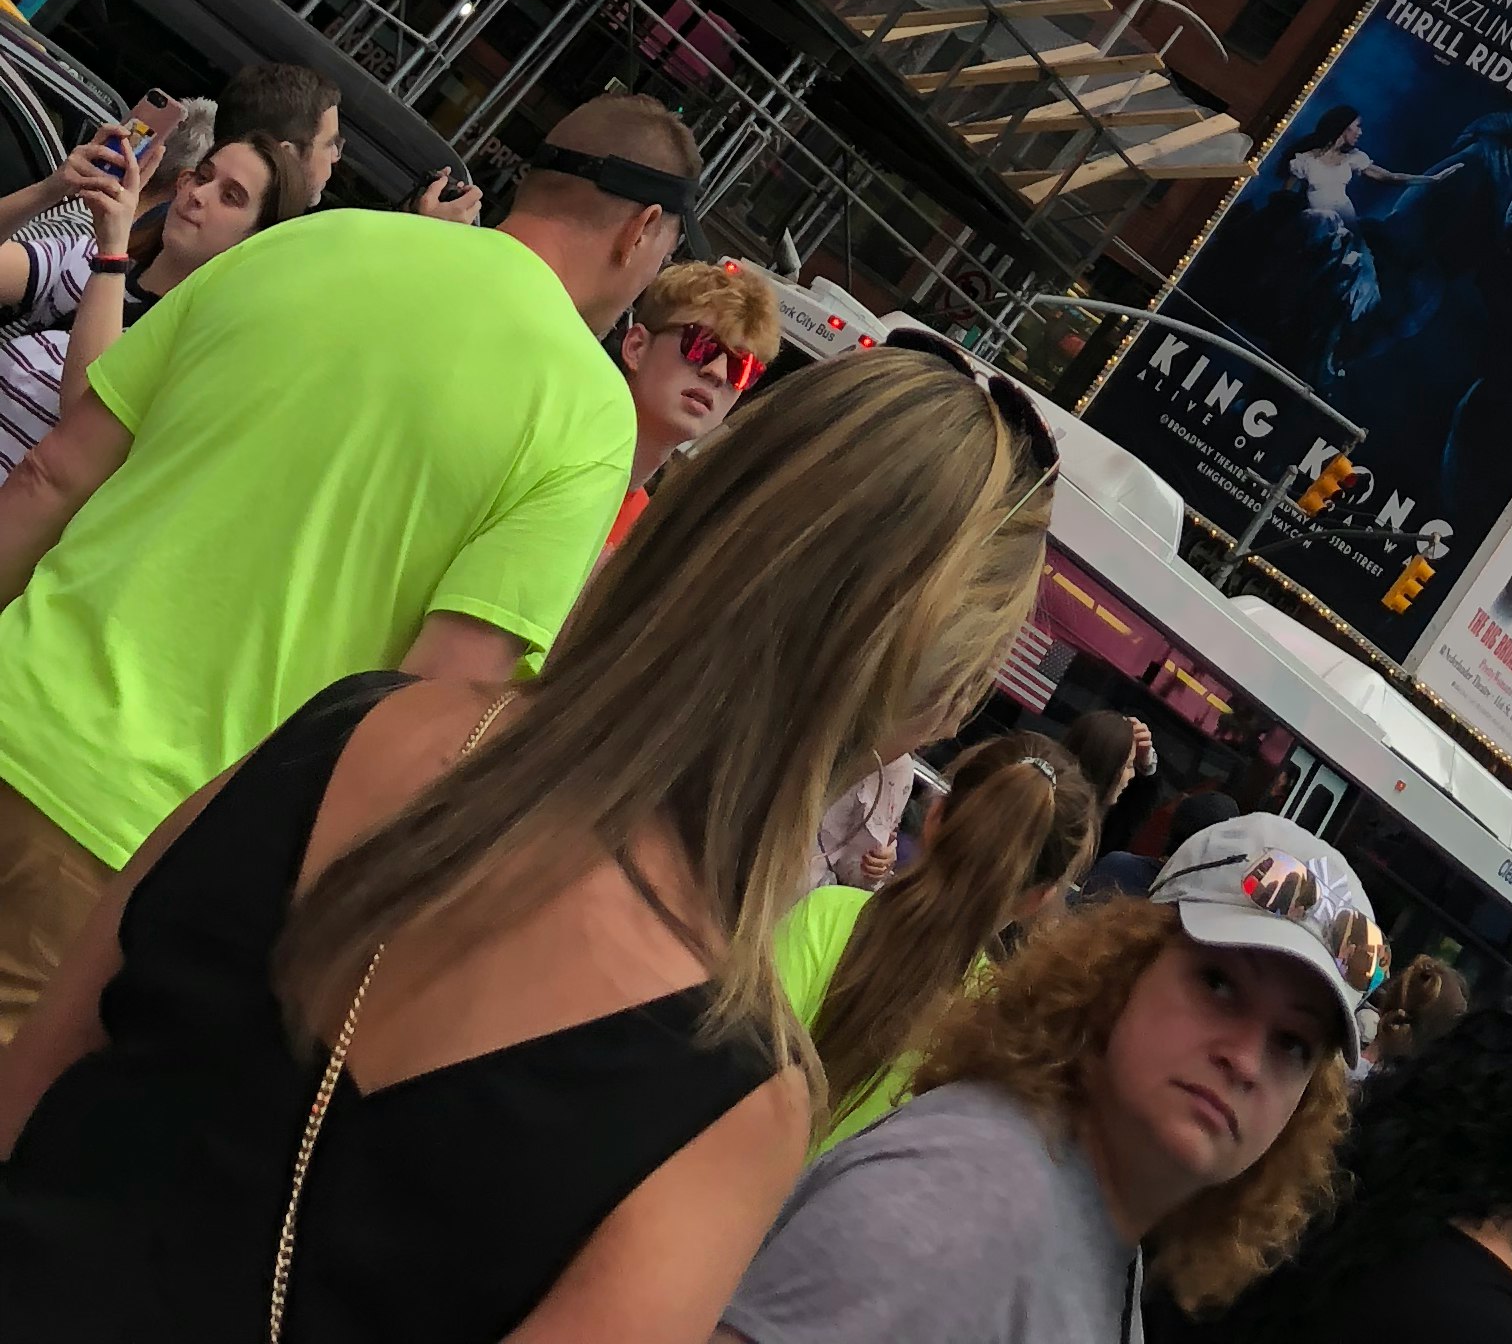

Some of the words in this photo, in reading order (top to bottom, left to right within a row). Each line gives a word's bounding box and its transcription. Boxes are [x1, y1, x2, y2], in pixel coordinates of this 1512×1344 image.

[780, 301, 797, 319] ork
[796, 312, 816, 331] City
[815, 323, 836, 342] Bus
[1137, 368, 1214, 425] ALIVE
[1234, 436, 1265, 463] ON
[1149, 333, 1278, 438] KING
[1167, 417, 1214, 456] BROADWAY
[1213, 448, 1249, 484] THEATRE
[1352, 551, 1384, 578] STREET
[1467, 607, 1490, 638] THE
[1480, 620, 1503, 650] BIG
